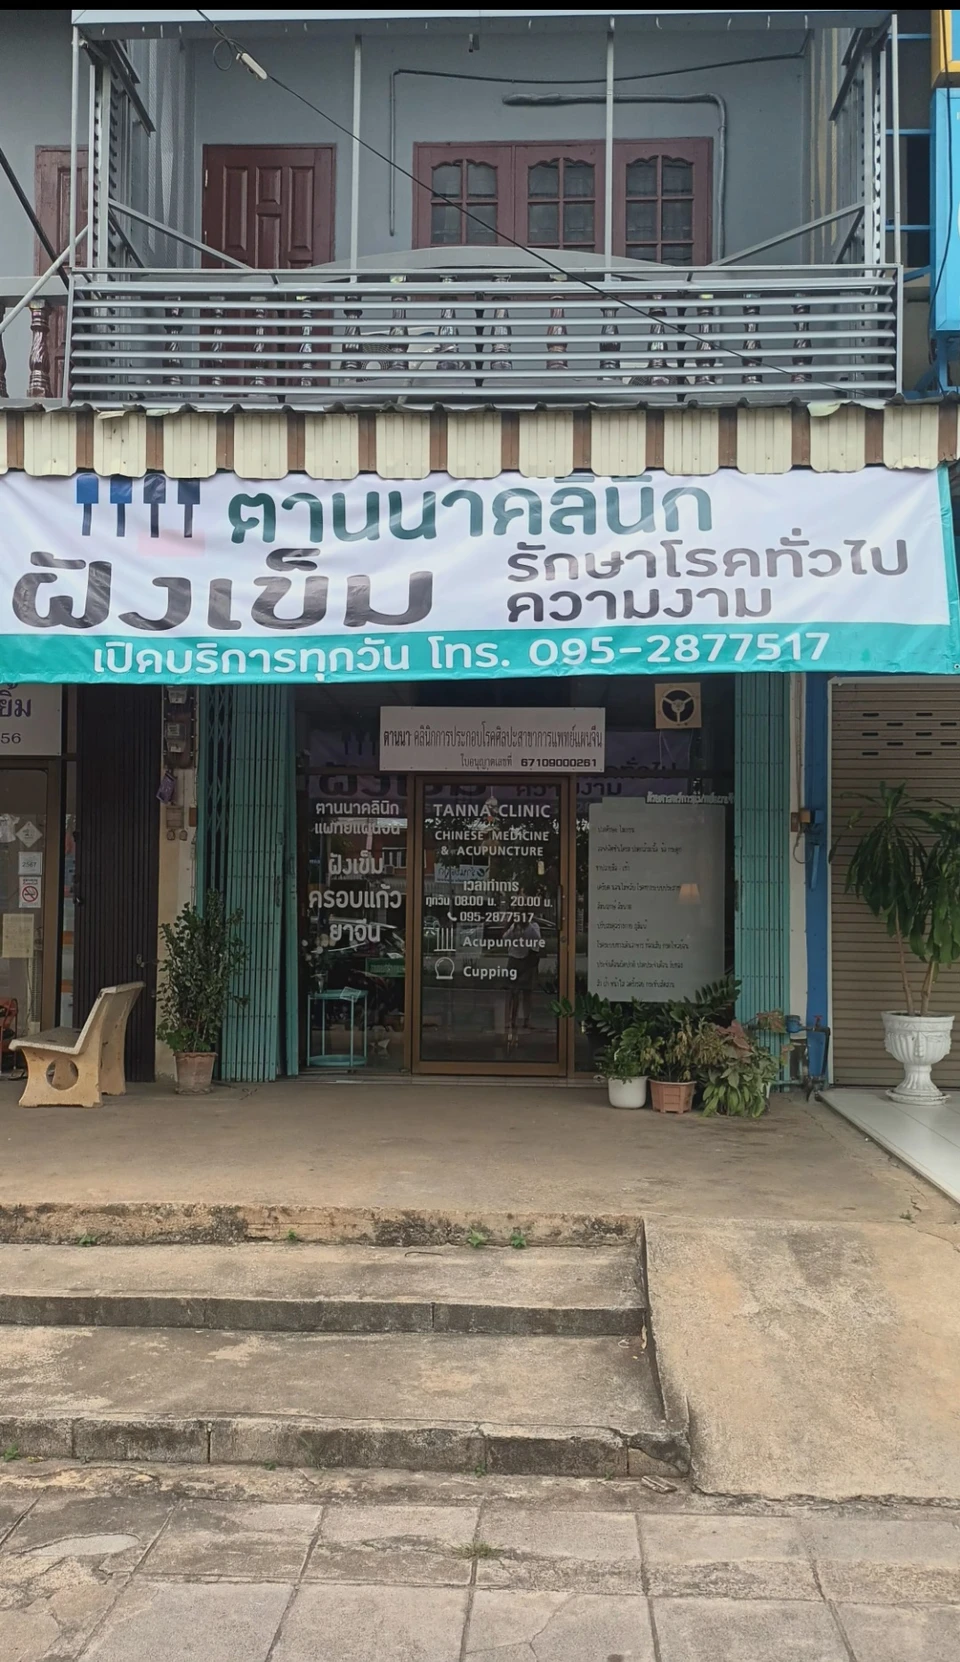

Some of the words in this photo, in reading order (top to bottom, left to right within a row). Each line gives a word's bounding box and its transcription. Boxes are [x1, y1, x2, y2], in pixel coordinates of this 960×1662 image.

[228, 475, 712, 543] ตานนาคลินิก
[507, 527, 908, 583] รักษาโรคทั่วไป
[12, 547, 433, 632] ฝังเข็ม
[507, 586, 772, 623] ความงาม
[93, 636, 410, 682] เปิดบริการทุกวัน
[428, 636, 510, 669] โทร.
[528, 632, 831, 667] 095-2877517
[461, 753, 512, 770] ใบอนุญาตเลขที่
[520, 758, 597, 768] 67109000261
[315, 800, 399, 815] ตานนาคลินิก
[433, 804, 492, 817] TANNA
[498, 804, 551, 818] CLINIC
[435, 830, 485, 841] CHINESE
[492, 830, 549, 841] MEDICINE
[441, 846, 449, 856] &
[456, 846, 544, 857] ACUPUNCTURE
[328, 850, 383, 875] ฝังเข็ม
[308, 883, 402, 909] ครอบแก้ว
[454, 895, 484, 906] 08.00
[487, 897, 497, 907] น.
[510, 896, 541, 907] 20.00
[543, 898, 553, 908] น.
[460, 911, 534, 922] 095-2877517
[462, 937, 546, 949] Acupuncture
[463, 966, 518, 980] Cupping
